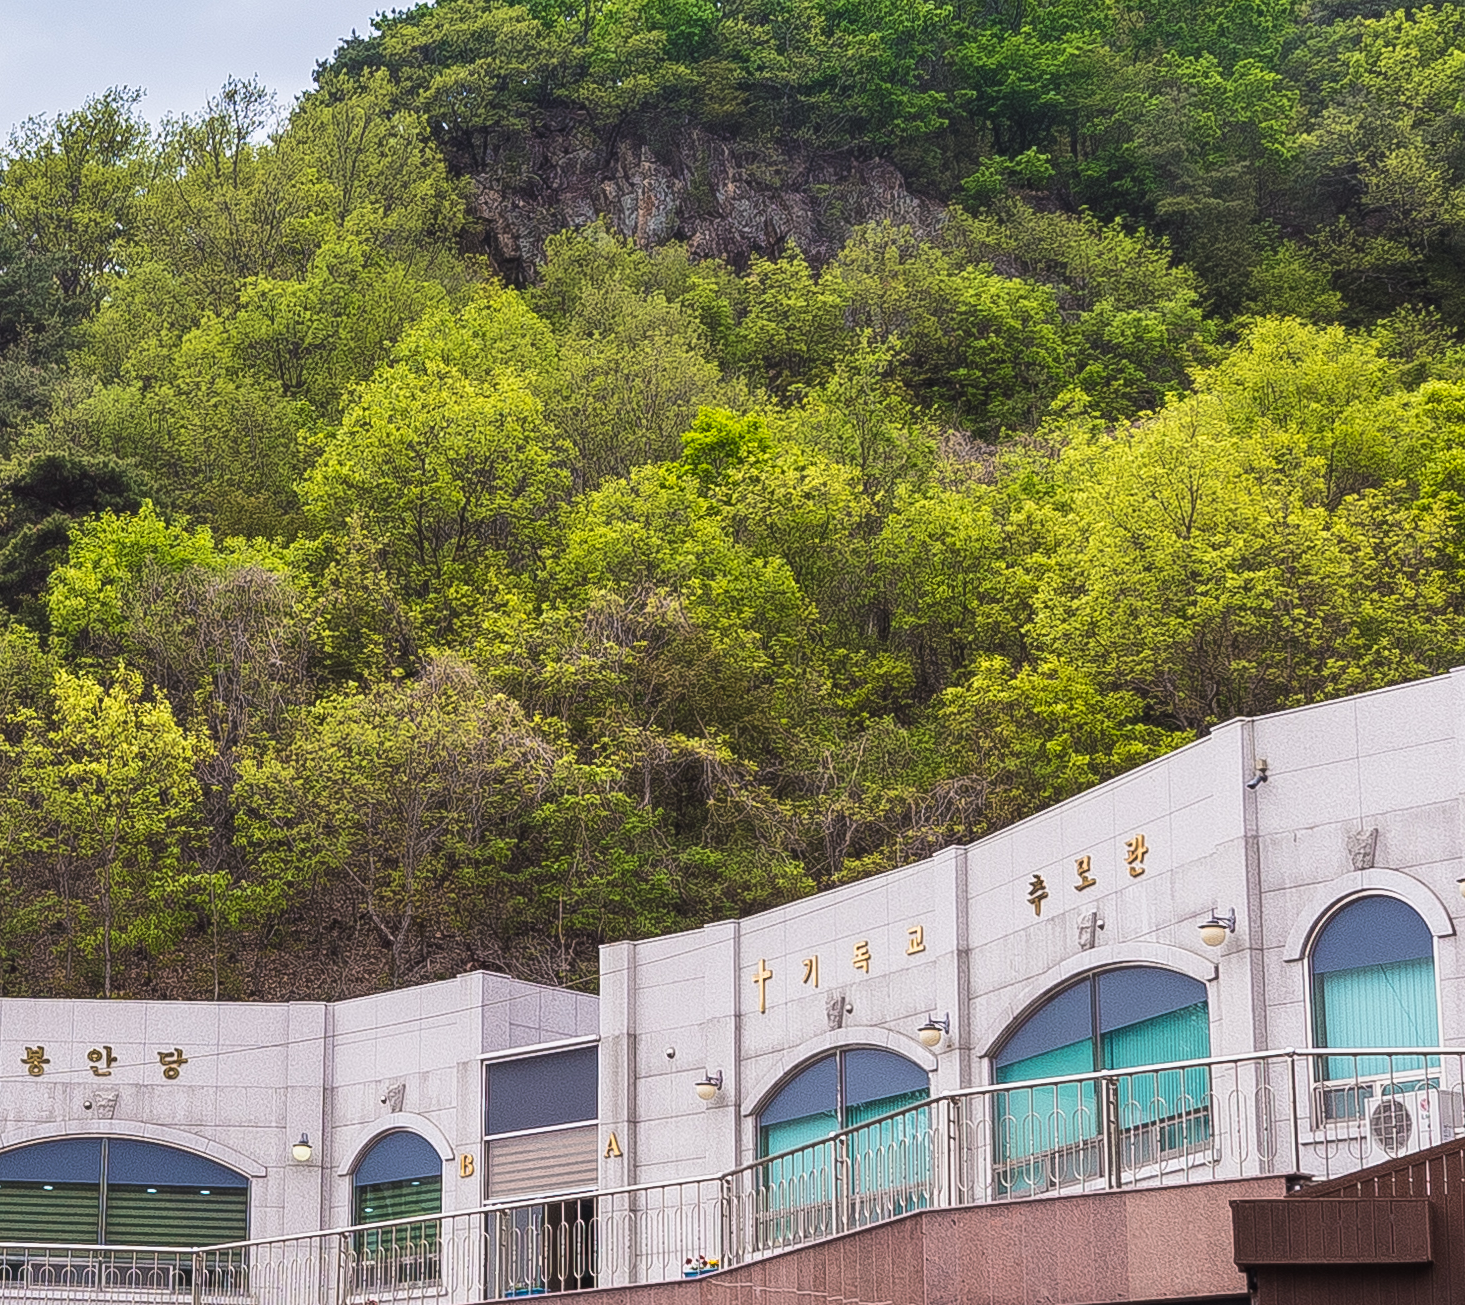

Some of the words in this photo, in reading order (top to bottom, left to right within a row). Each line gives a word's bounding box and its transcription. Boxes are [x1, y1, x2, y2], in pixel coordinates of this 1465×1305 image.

[802, 925, 926, 988] 기독교
[1026, 833, 1149, 917] 추모관
[20, 1046, 189, 1080] 봉안당
[604, 1131, 623, 1159] A
[460, 1153, 475, 1178] B
